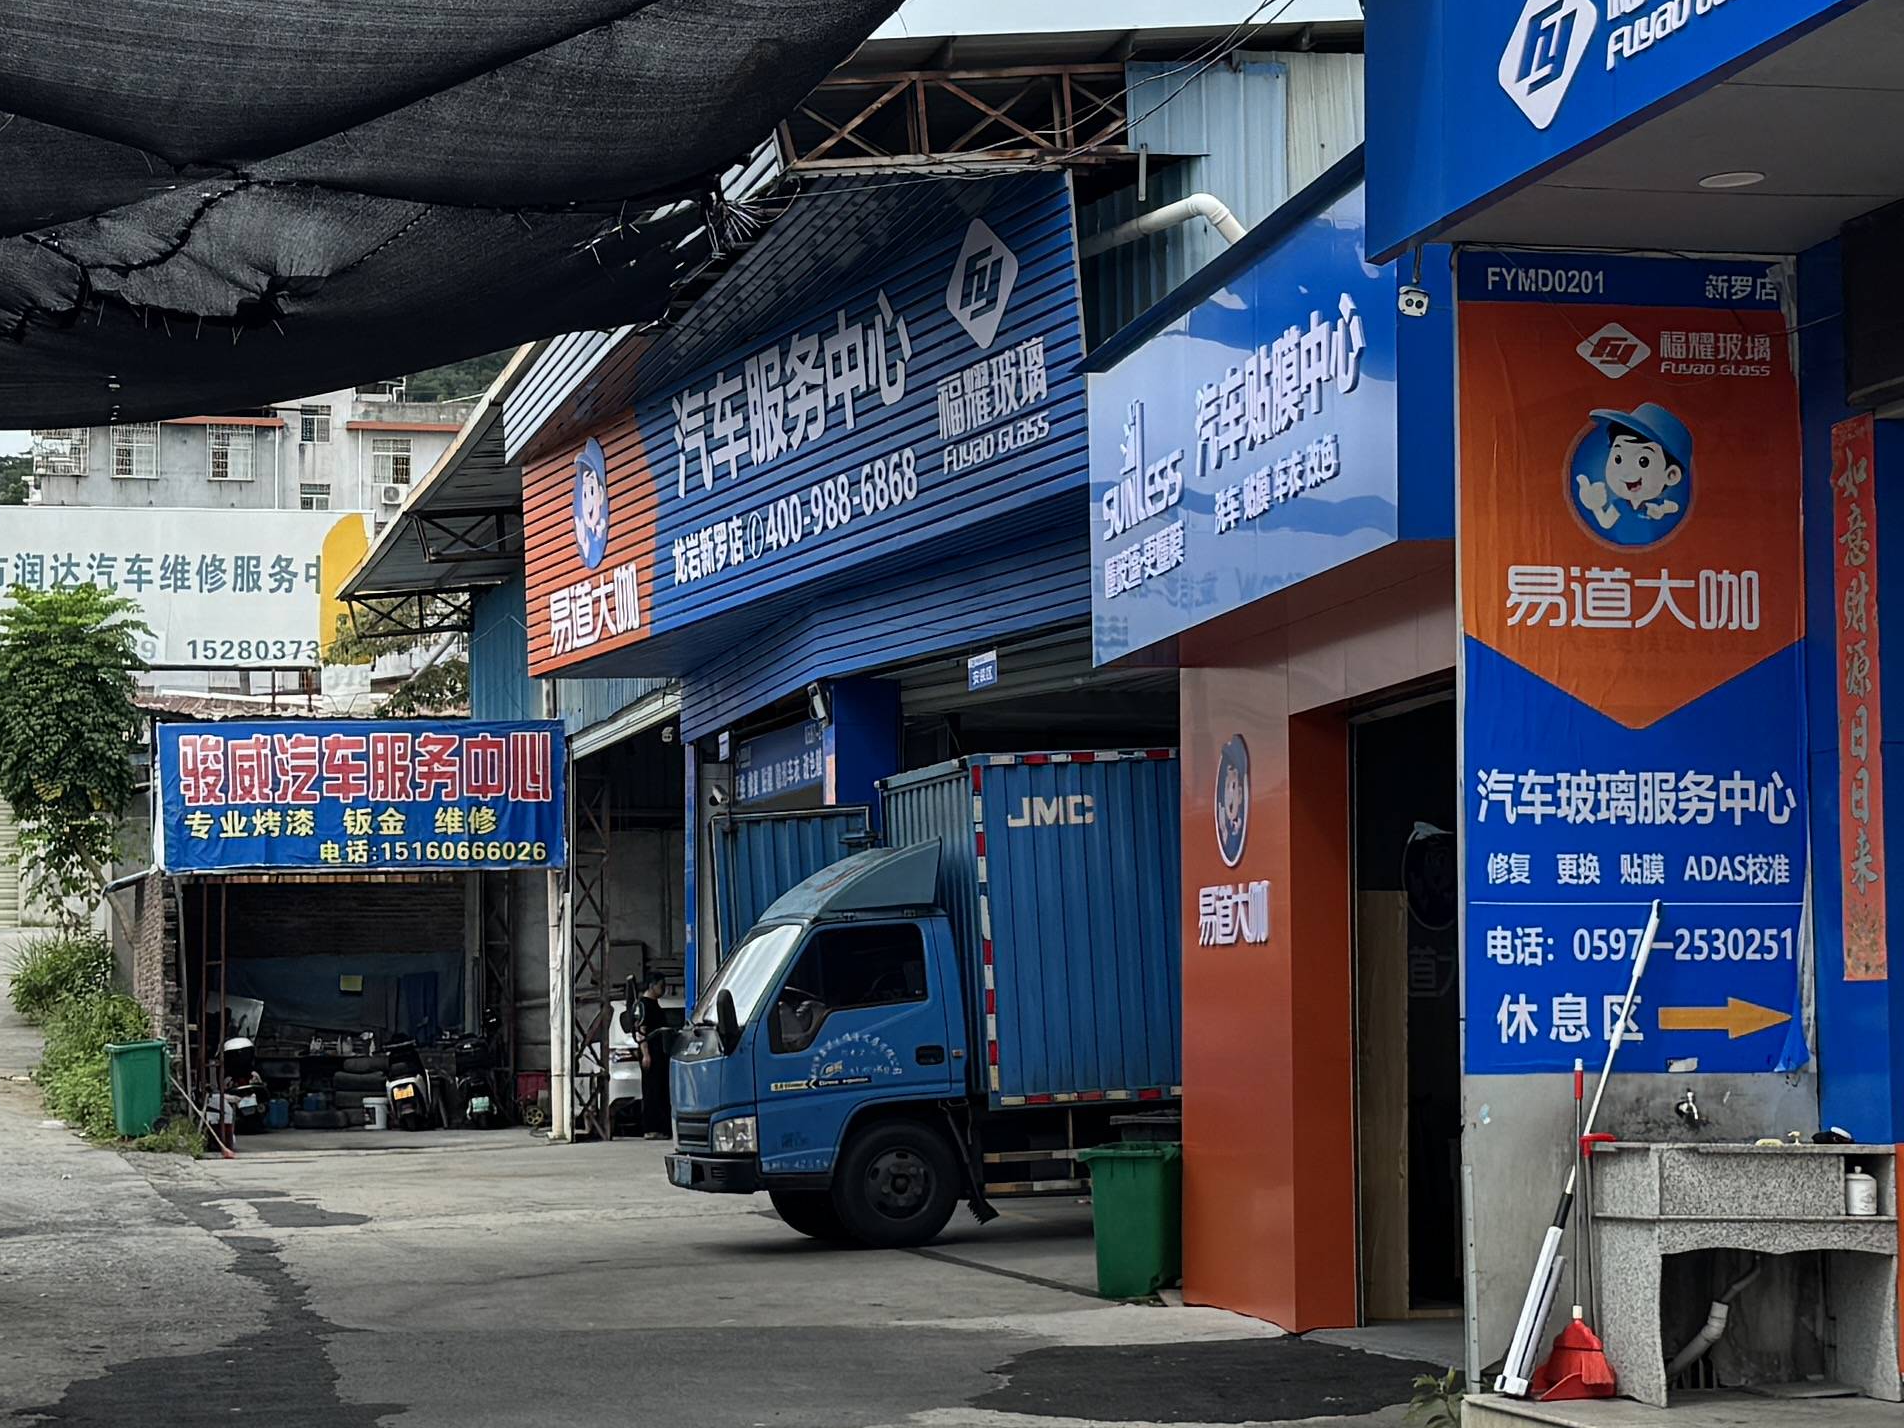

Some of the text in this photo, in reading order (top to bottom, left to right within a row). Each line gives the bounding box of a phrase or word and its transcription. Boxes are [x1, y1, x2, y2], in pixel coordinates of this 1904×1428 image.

[1487, 267, 1778, 302] FYMD0201 新罗店
[1659, 330, 1771, 362] 福耀玻璃
[672, 288, 913, 499] 汽车服务中心
[937, 336, 1048, 440] 福耀玻璃
[1196, 293, 1366, 477] 汽车贴膜中心
[672, 446, 919, 586] 龙岩新罗店 400-988-6868
[549, 562, 640, 658] 易道大咖
[1506, 565, 1760, 630] 易道大咖
[179, 732, 552, 804] 骏威汽车服务中心
[1477, 769, 1797, 826] 汽车玻璃服务中心
[184, 805, 498, 838] 专业烤漆 钣金 维修
[1007, 794, 1096, 829] JMC
[1487, 853, 1790, 885] 修复 更换 贴膜 ADAS校准
[1197, 879, 1270, 948] 易道大咖
[1496, 993, 1645, 1044] 休息区
